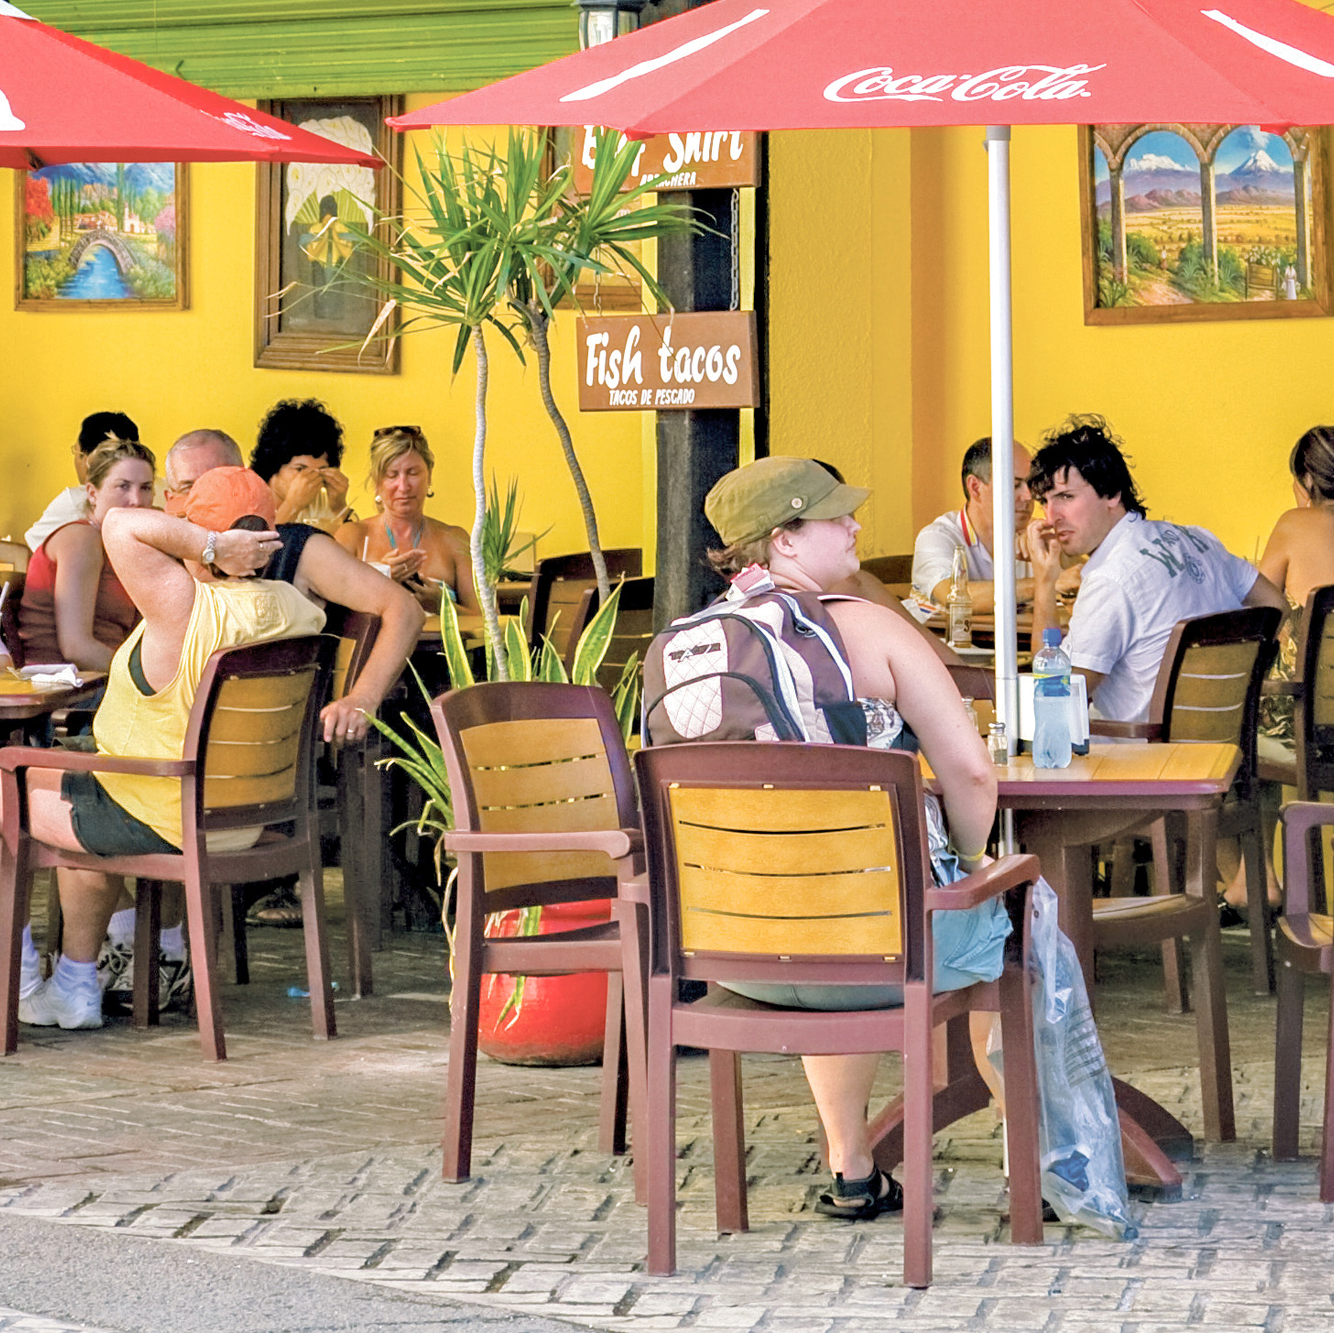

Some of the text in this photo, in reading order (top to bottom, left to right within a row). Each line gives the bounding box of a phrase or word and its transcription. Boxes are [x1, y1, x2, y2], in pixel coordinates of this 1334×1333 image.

[822, 63, 1107, 102] Coca-Cola
[585, 325, 741, 389] Fish tacos
[609, 387, 696, 406] TACOS DE PESCADO
